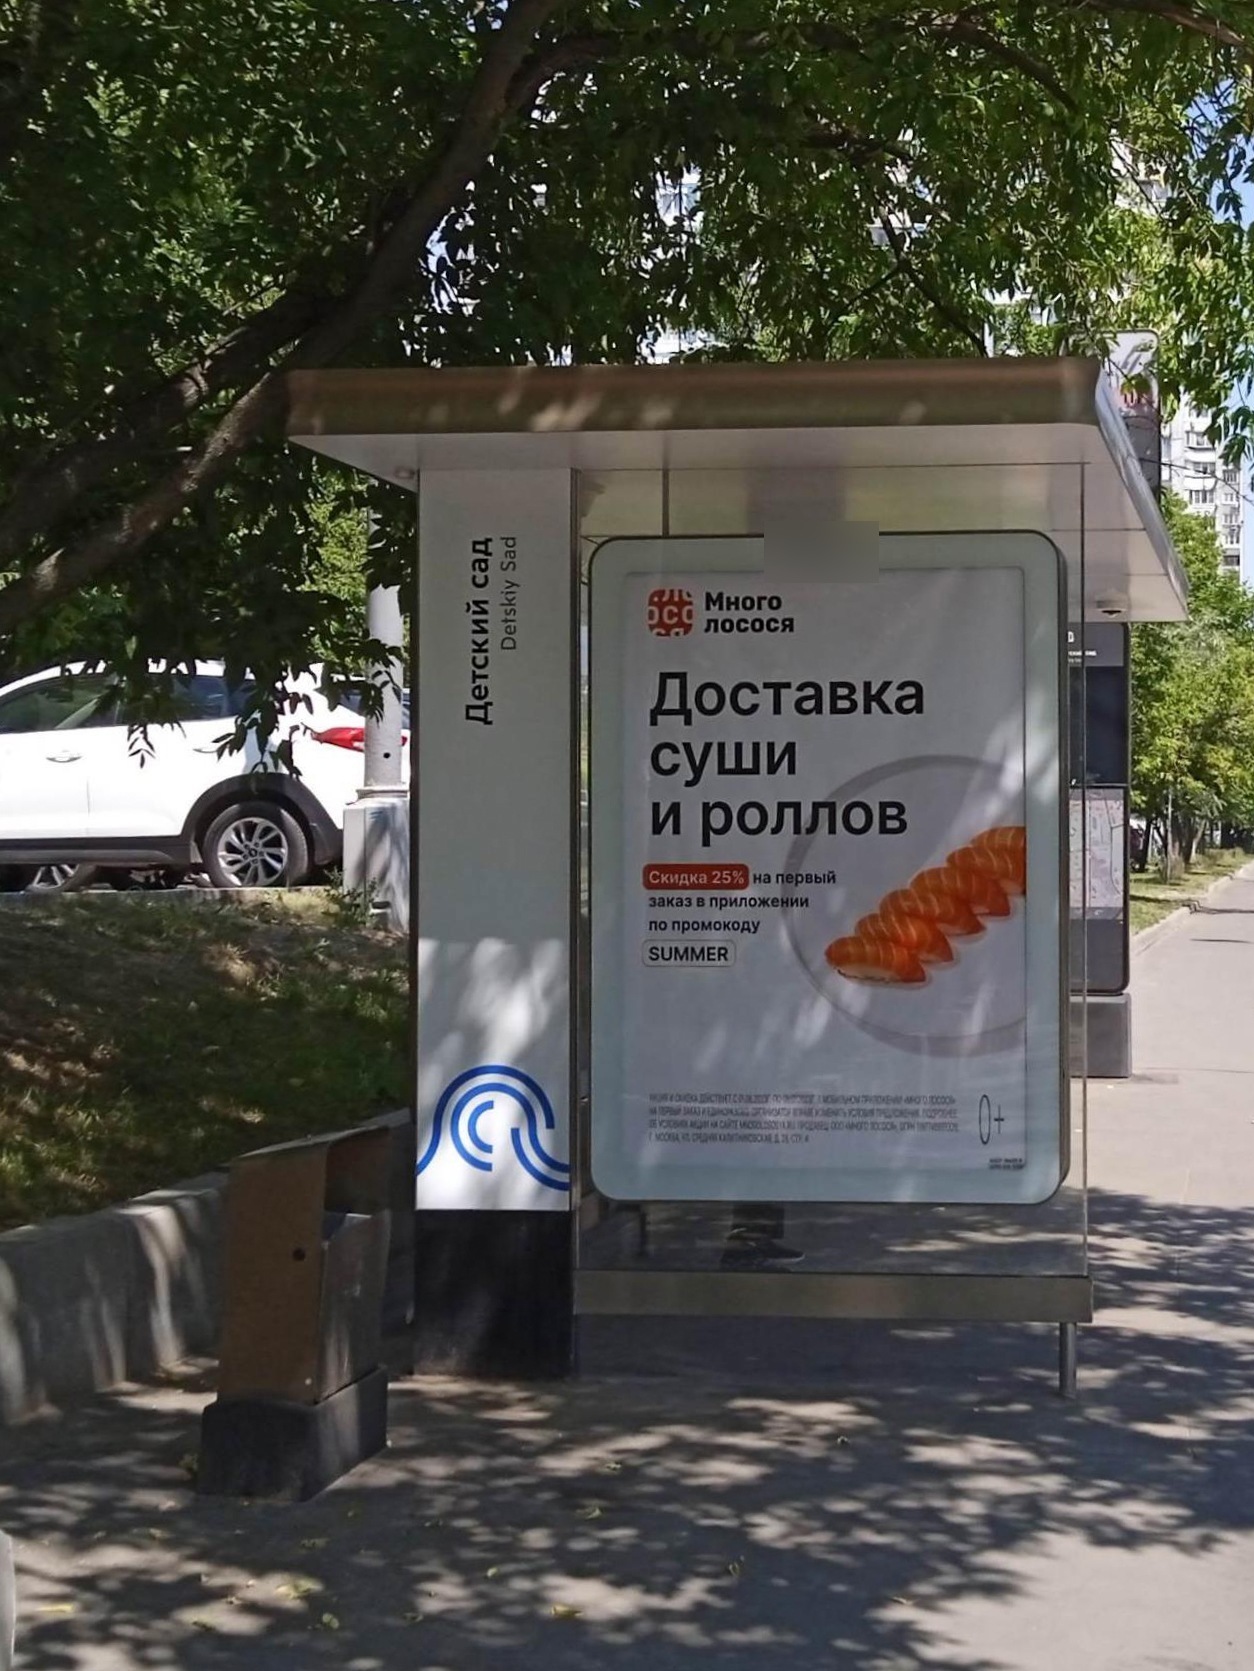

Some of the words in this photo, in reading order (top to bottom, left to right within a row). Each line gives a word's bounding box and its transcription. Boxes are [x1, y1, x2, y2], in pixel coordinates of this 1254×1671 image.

[471, 537, 493, 589] сад
[500, 536, 517, 572] Sad
[500, 579, 521, 650] Detskiy
[704, 591, 782, 612] Много
[704, 617, 795, 633] лосося
[465, 600, 493, 725] Детский
[650, 671, 924, 726] Доставка
[650, 740, 797, 788] суши
[651, 801, 682, 836] и
[701, 801, 908, 848] роллов
[649, 870, 708, 886] Скидка
[712, 870, 745, 885] 25%
[752, 872, 771, 885] на
[775, 870, 837, 887] первый
[648, 896, 693, 909] заказ
[696, 896, 706, 908] в
[709, 896, 810, 911] приложении
[648, 919, 668, 932] по
[671, 919, 761, 935] промокоду
[648, 945, 729, 962] SUMMER
